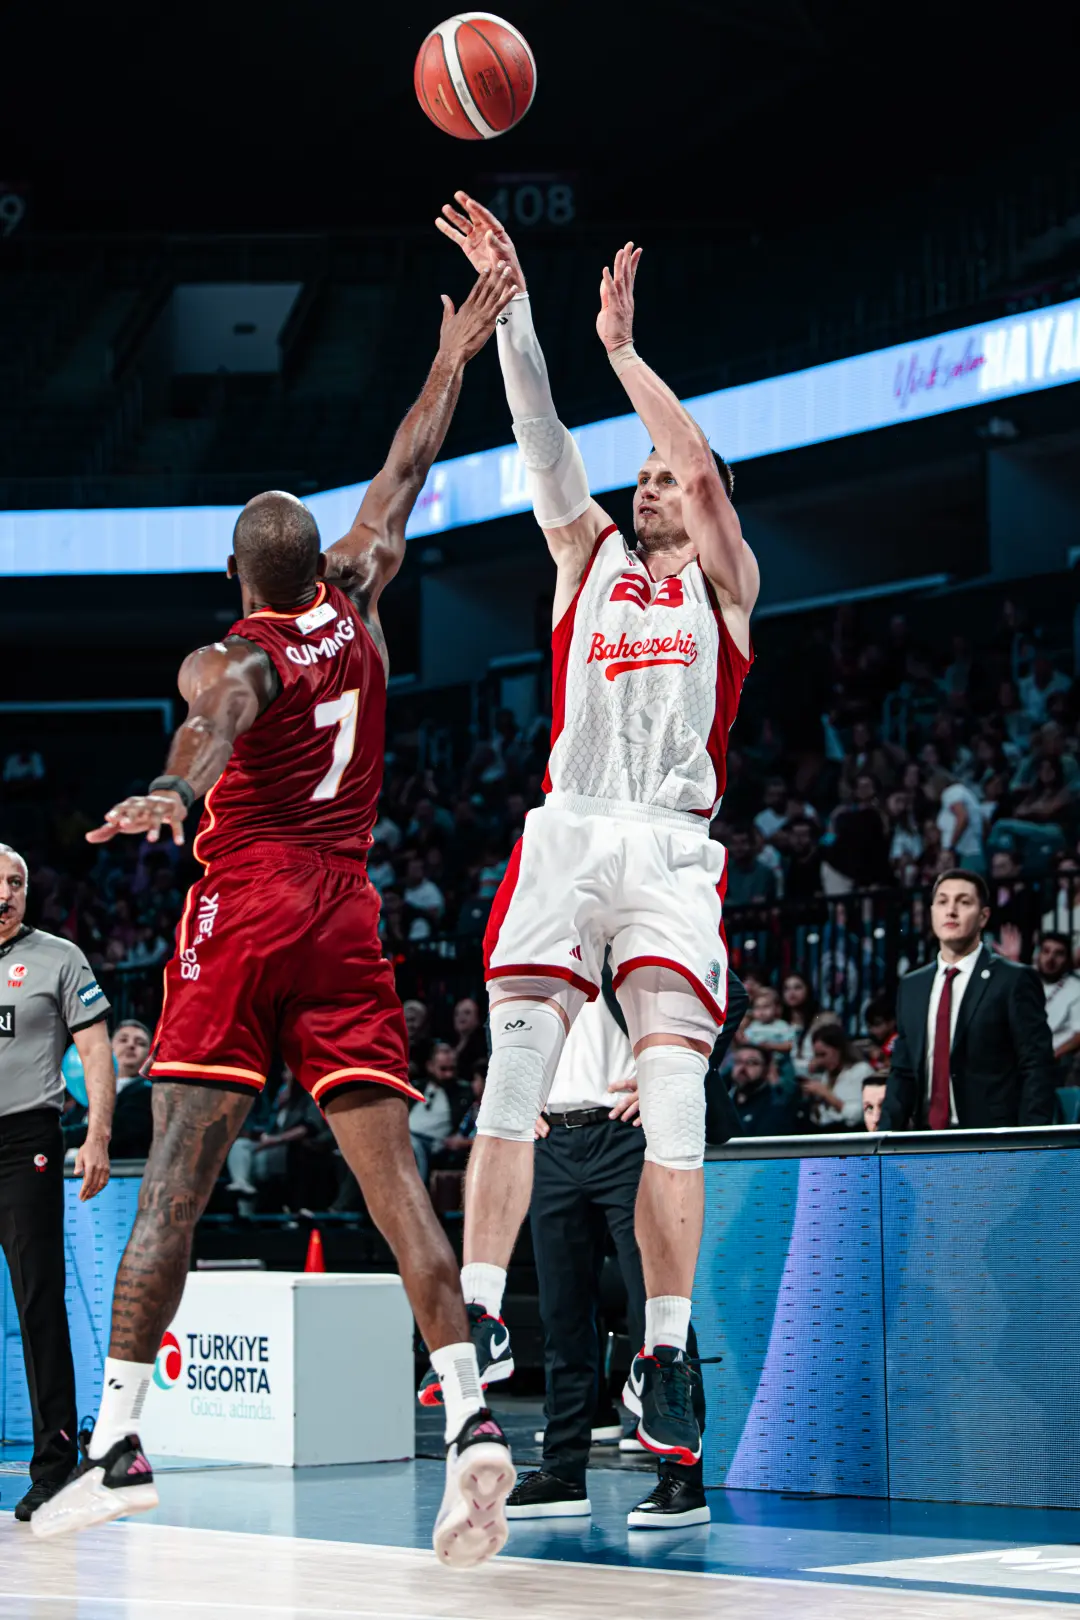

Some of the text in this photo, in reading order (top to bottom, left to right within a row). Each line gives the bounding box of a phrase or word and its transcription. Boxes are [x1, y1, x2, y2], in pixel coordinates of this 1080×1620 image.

[609, 573, 684, 611] 23
[309, 688, 360, 801] 7
[187, 1333, 269, 1362] TÜRKİYE
[187, 1364, 271, 1394] SİGORTA
